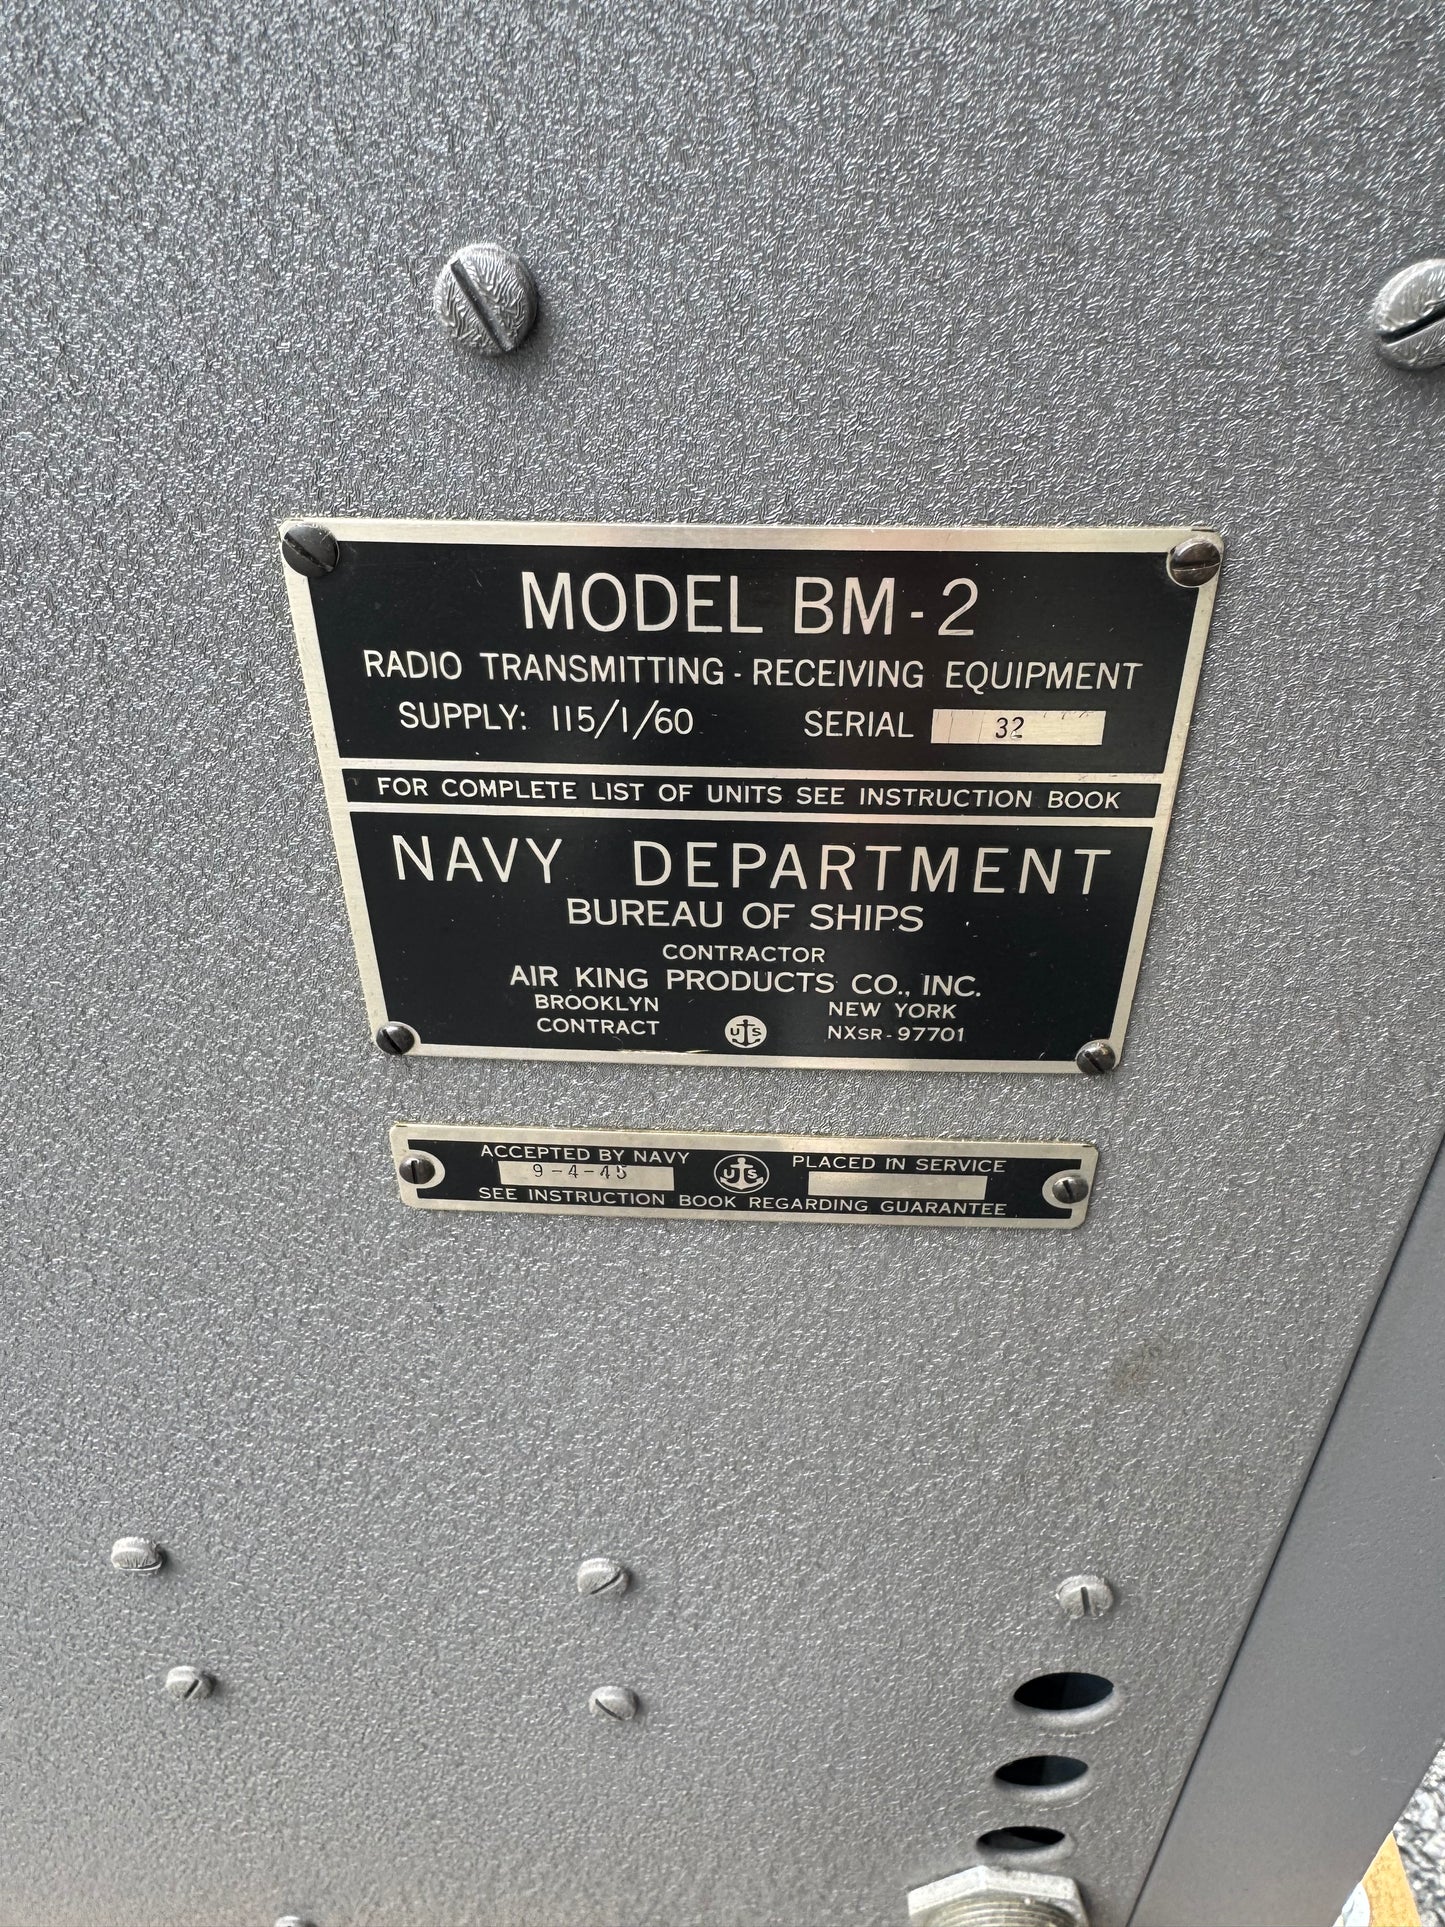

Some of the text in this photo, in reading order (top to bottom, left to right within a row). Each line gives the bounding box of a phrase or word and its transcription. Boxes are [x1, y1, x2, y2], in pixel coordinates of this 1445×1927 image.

[521, 571, 764, 634] MODEL
[363, 649, 462, 680] RADIO
[945, 660, 1144, 695] EQUIPMENT
[398, 699, 694, 741] SUPPLY: 115/1/60
[804, 710, 1025, 740] SERIAL 32
[377, 776, 1121, 810] FOR COMPLETE LIST OF UNITS SEE INSTRUCTION BOOK
[391, 833, 1112, 895] NAVY DEPARTMENT
[566, 897, 924, 933] BUREAU OF SHIPS
[662, 943, 826, 963] CONTRACTOR
[509, 964, 981, 998] AIR KING PRODUCTS CO., INC.
[534, 993, 659, 1012] BROOKLYN
[828, 1001, 957, 1019] NEW YORK
[536, 1017, 660, 1035] CONTRACT
[480, 1144, 690, 1165] ACCEPTED BY NAVY
[792, 1155, 1007, 1173] PLACED IN SERVICE
[478, 1186, 1007, 1216] SEE INSTRUCTION BOOK REGARDING GUARANTEE
